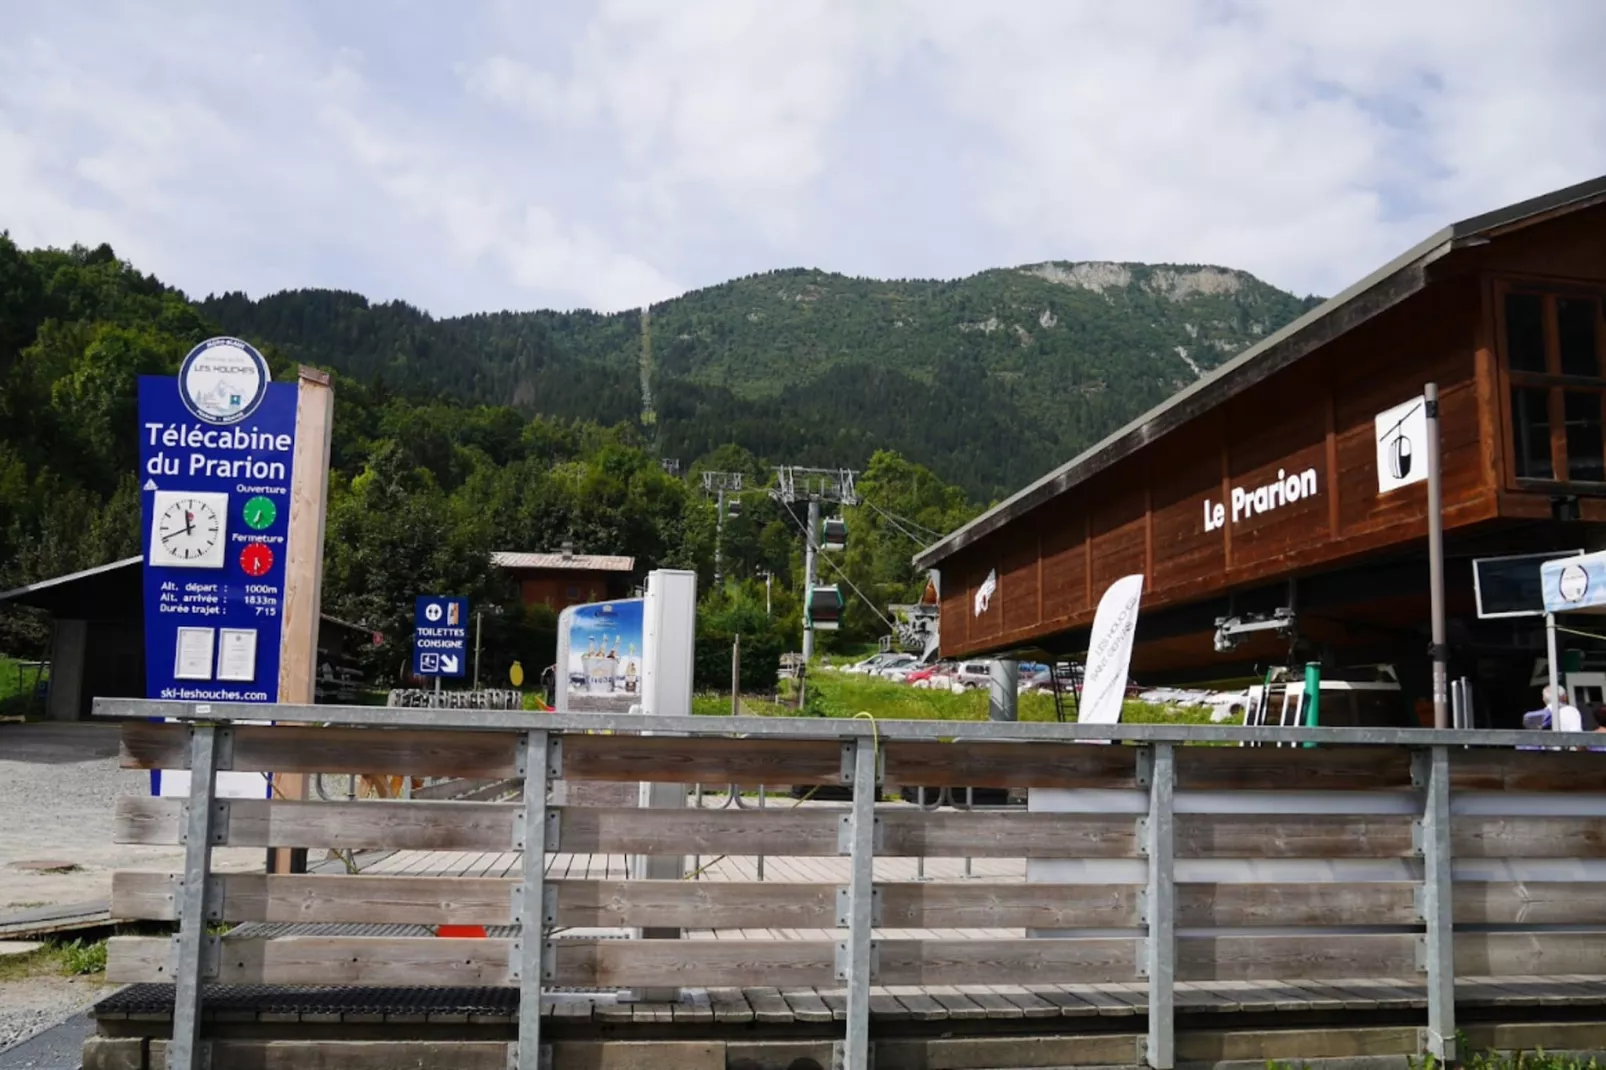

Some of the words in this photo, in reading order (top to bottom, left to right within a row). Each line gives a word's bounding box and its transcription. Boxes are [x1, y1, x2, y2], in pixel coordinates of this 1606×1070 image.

[145, 423, 292, 450] Télécabine
[147, 452, 179, 475] du
[189, 454, 285, 480] Prarion
[236, 484, 286, 494] Ouverture
[1204, 499, 1225, 532] Le
[1231, 468, 1317, 523] Prarion
[232, 533, 284, 543] Fermeture
[161, 582, 178, 591] Alt.
[185, 583, 218, 593] départ
[245, 585, 278, 594] 1000m
[160, 593, 178, 602] Alt.
[183, 594, 218, 603] arrivée
[244, 596, 276, 605] 1833m
[160, 604, 189, 614] Durée
[192, 606, 220, 616] trajet
[417, 628, 465, 636] TOILETTES
[417, 639, 464, 648] CONSIGNE
[161, 688, 268, 700] ski-leshouches.com
